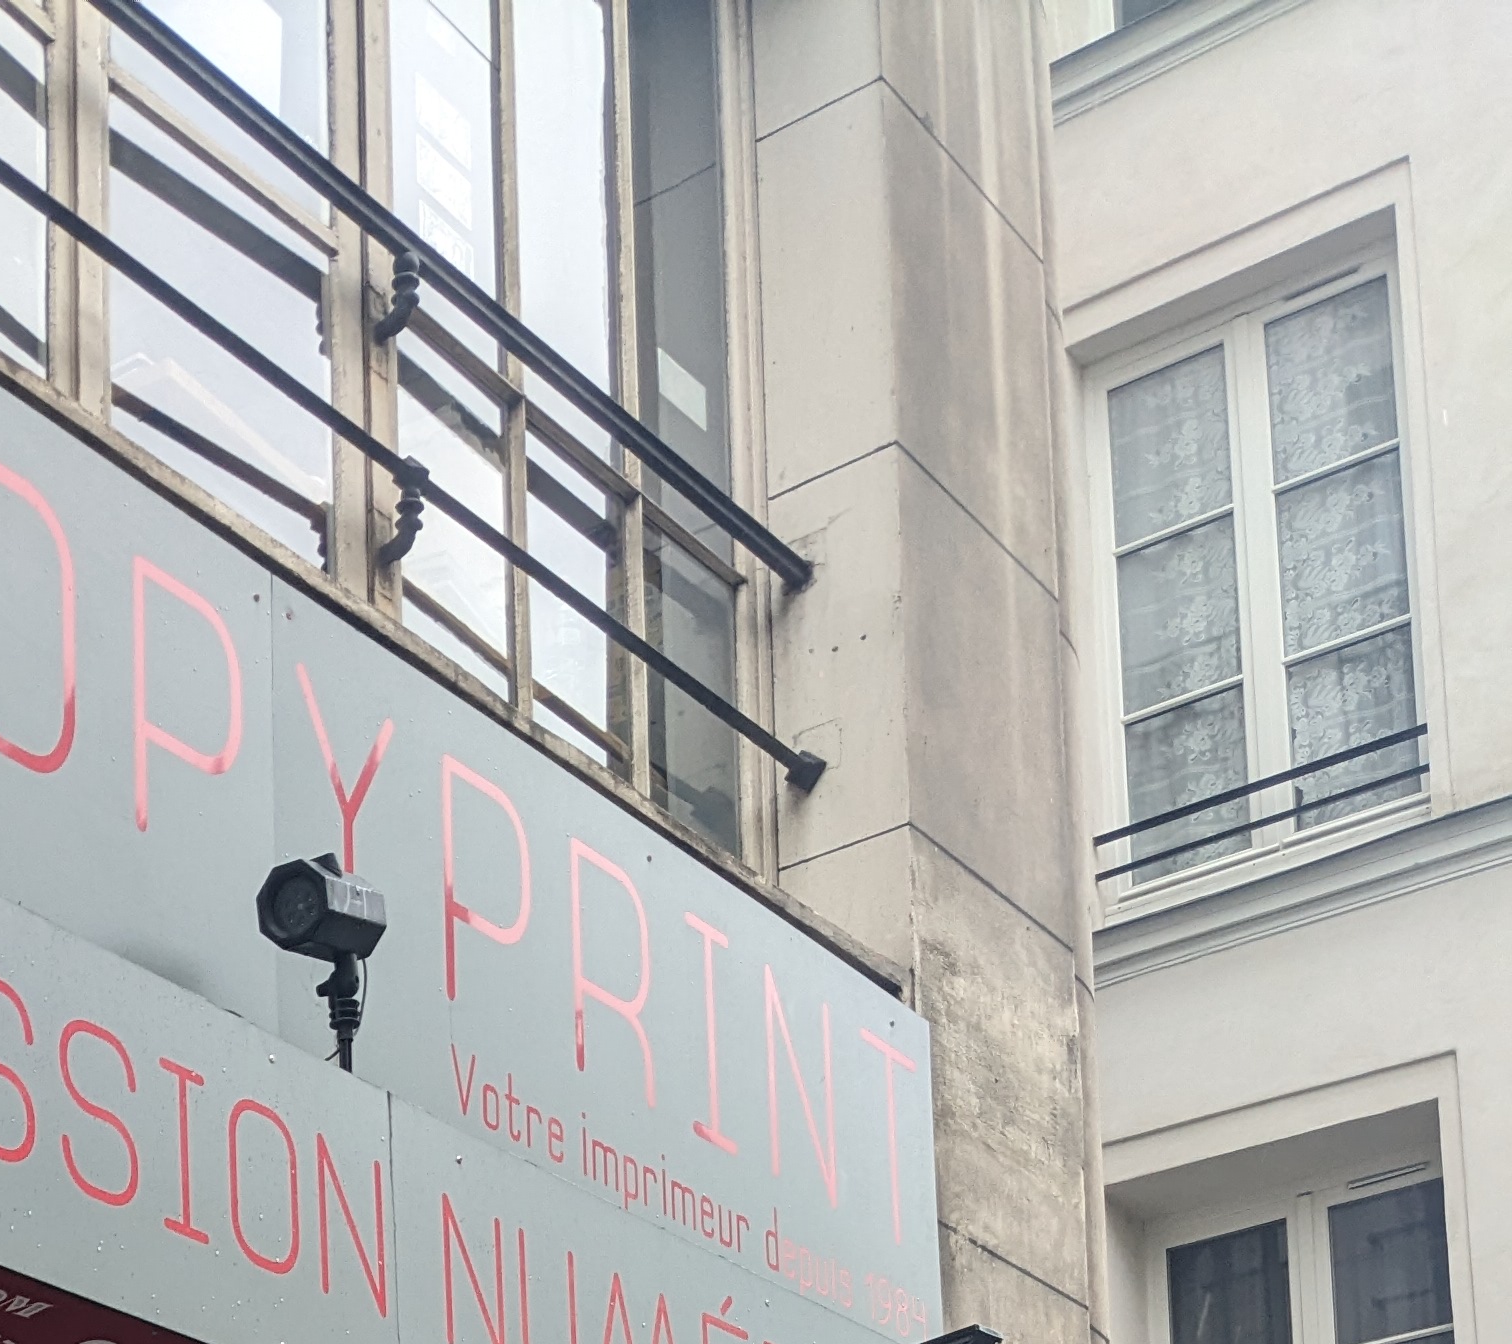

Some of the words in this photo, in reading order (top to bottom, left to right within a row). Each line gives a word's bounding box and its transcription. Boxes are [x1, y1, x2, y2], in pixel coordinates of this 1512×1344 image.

[450, 1043, 565, 1163] Votre
[581, 1112, 750, 1253] imprimeur
[765, 1207, 853, 1308] depuis
[864, 1272, 930, 1341] 1984
